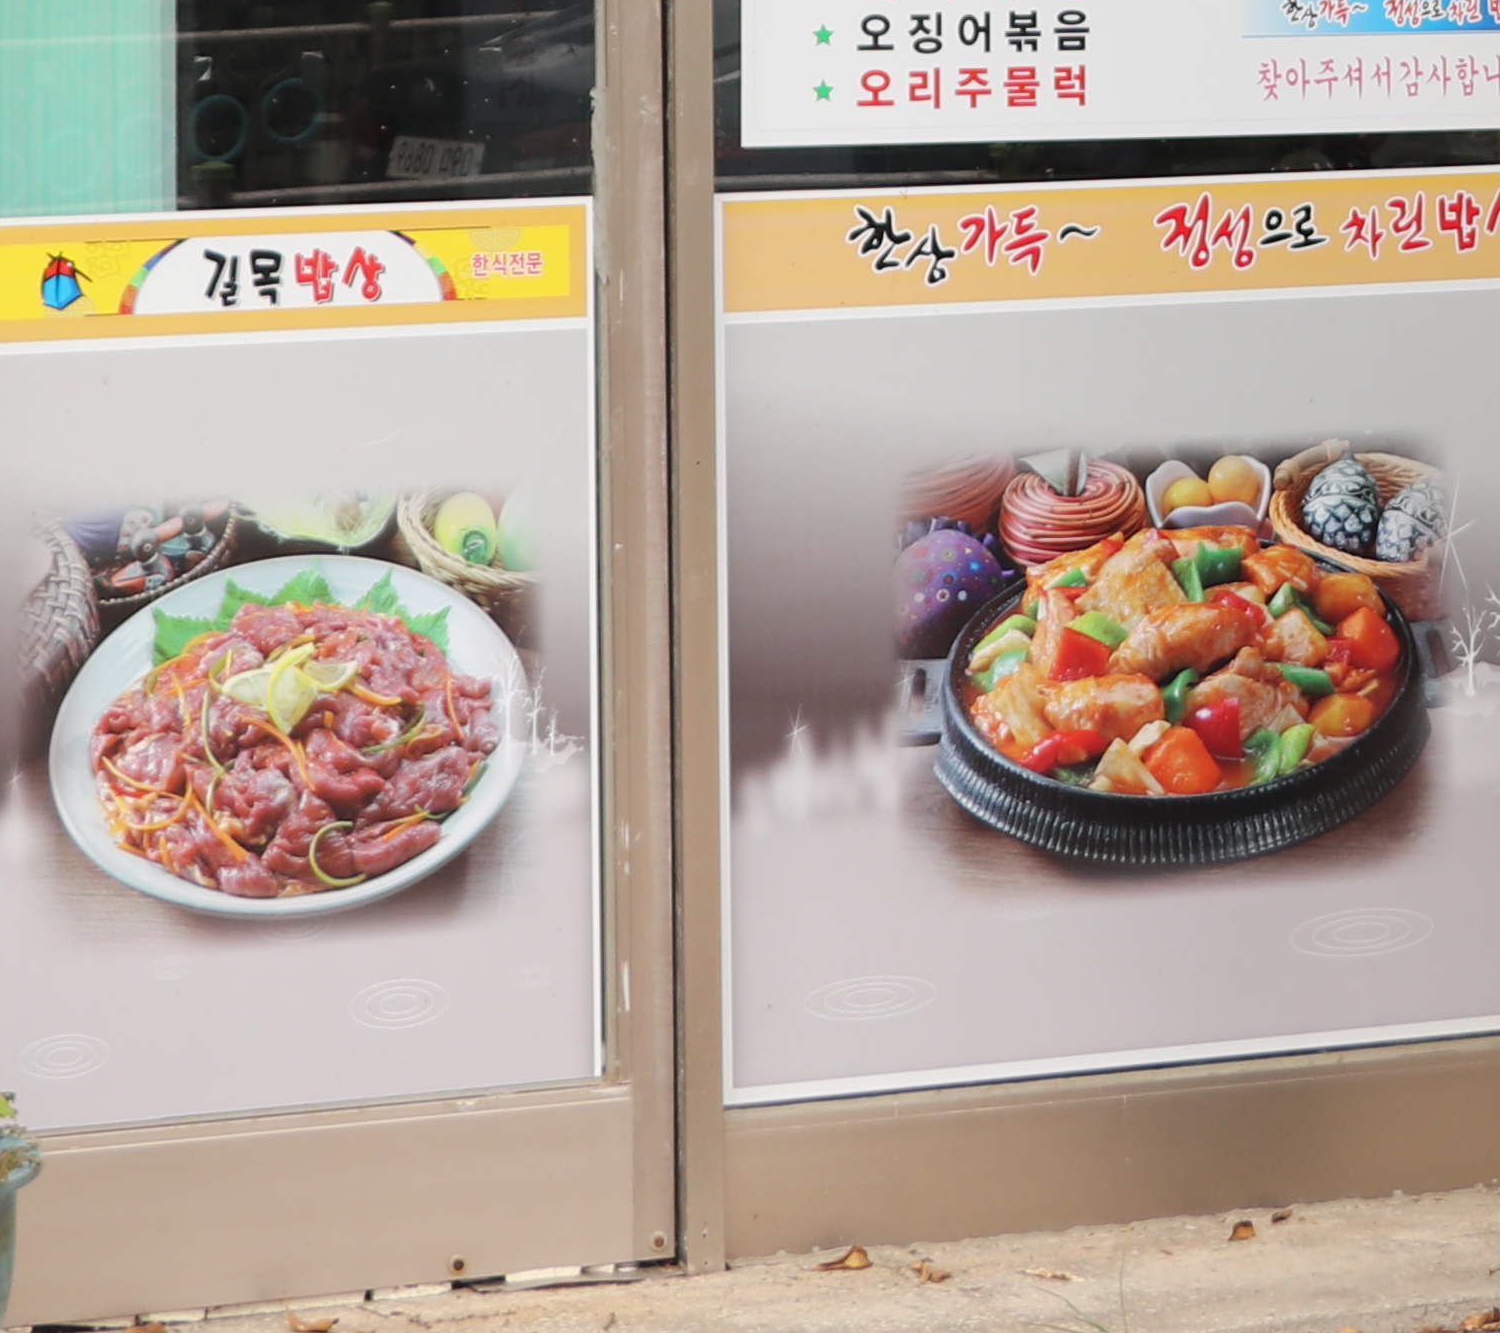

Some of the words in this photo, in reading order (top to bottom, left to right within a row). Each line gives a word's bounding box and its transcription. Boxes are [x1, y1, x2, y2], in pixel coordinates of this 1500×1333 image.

[857, 10, 1090, 53] 오징어볶음
[857, 66, 1088, 109] 오리주물럭
[1154, 191, 1329, 268] 정성으로
[1339, 193, 1429, 259] 차린
[470, 251, 544, 279] 한식전문
